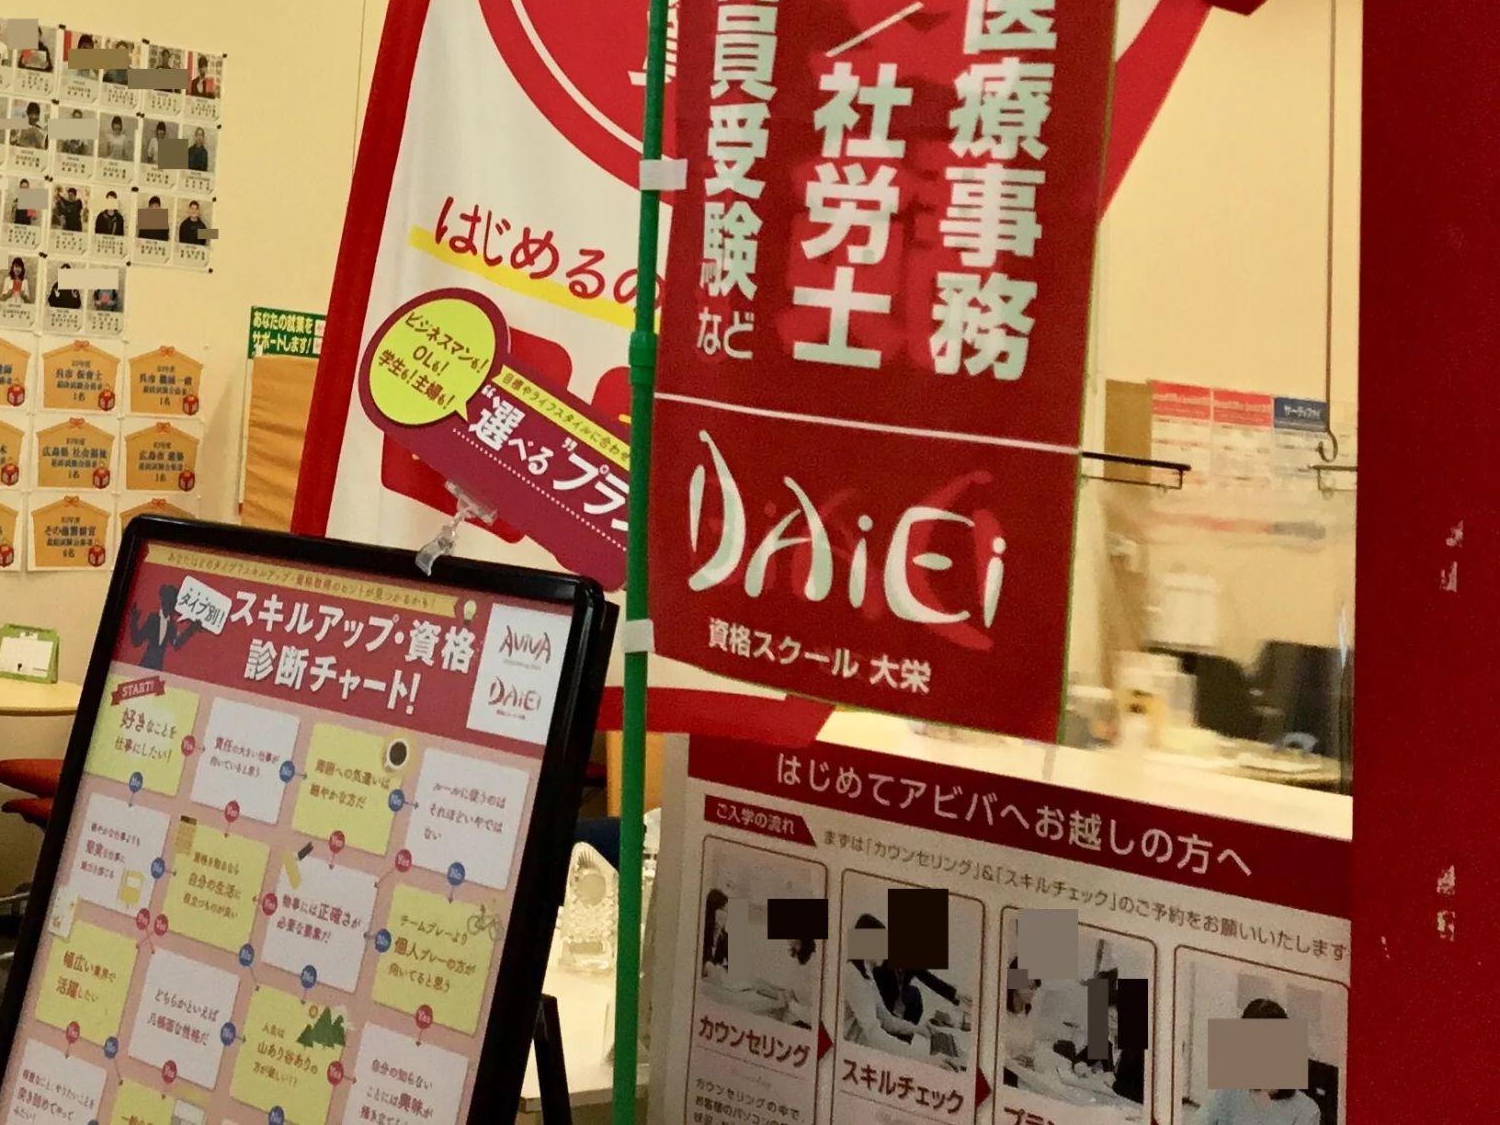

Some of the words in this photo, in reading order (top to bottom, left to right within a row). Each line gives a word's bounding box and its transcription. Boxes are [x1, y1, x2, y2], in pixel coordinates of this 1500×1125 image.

[230, 591, 476, 675] スキルアップ・資格
[707, 617, 859, 681] 資格スクール
[869, 653, 932, 695] 大栄
[122, 681, 155, 698] START!
[244, 638, 421, 716] 診断チャート!
[119, 707, 177, 740] 好きなことを
[715, 802, 796, 835] ご入学の流れ
[776, 752, 1253, 877] はじめてアビバへお越しの方へ
[699, 1014, 812, 1069] カウンセリング
[842, 1058, 966, 1116] スキルチェック
